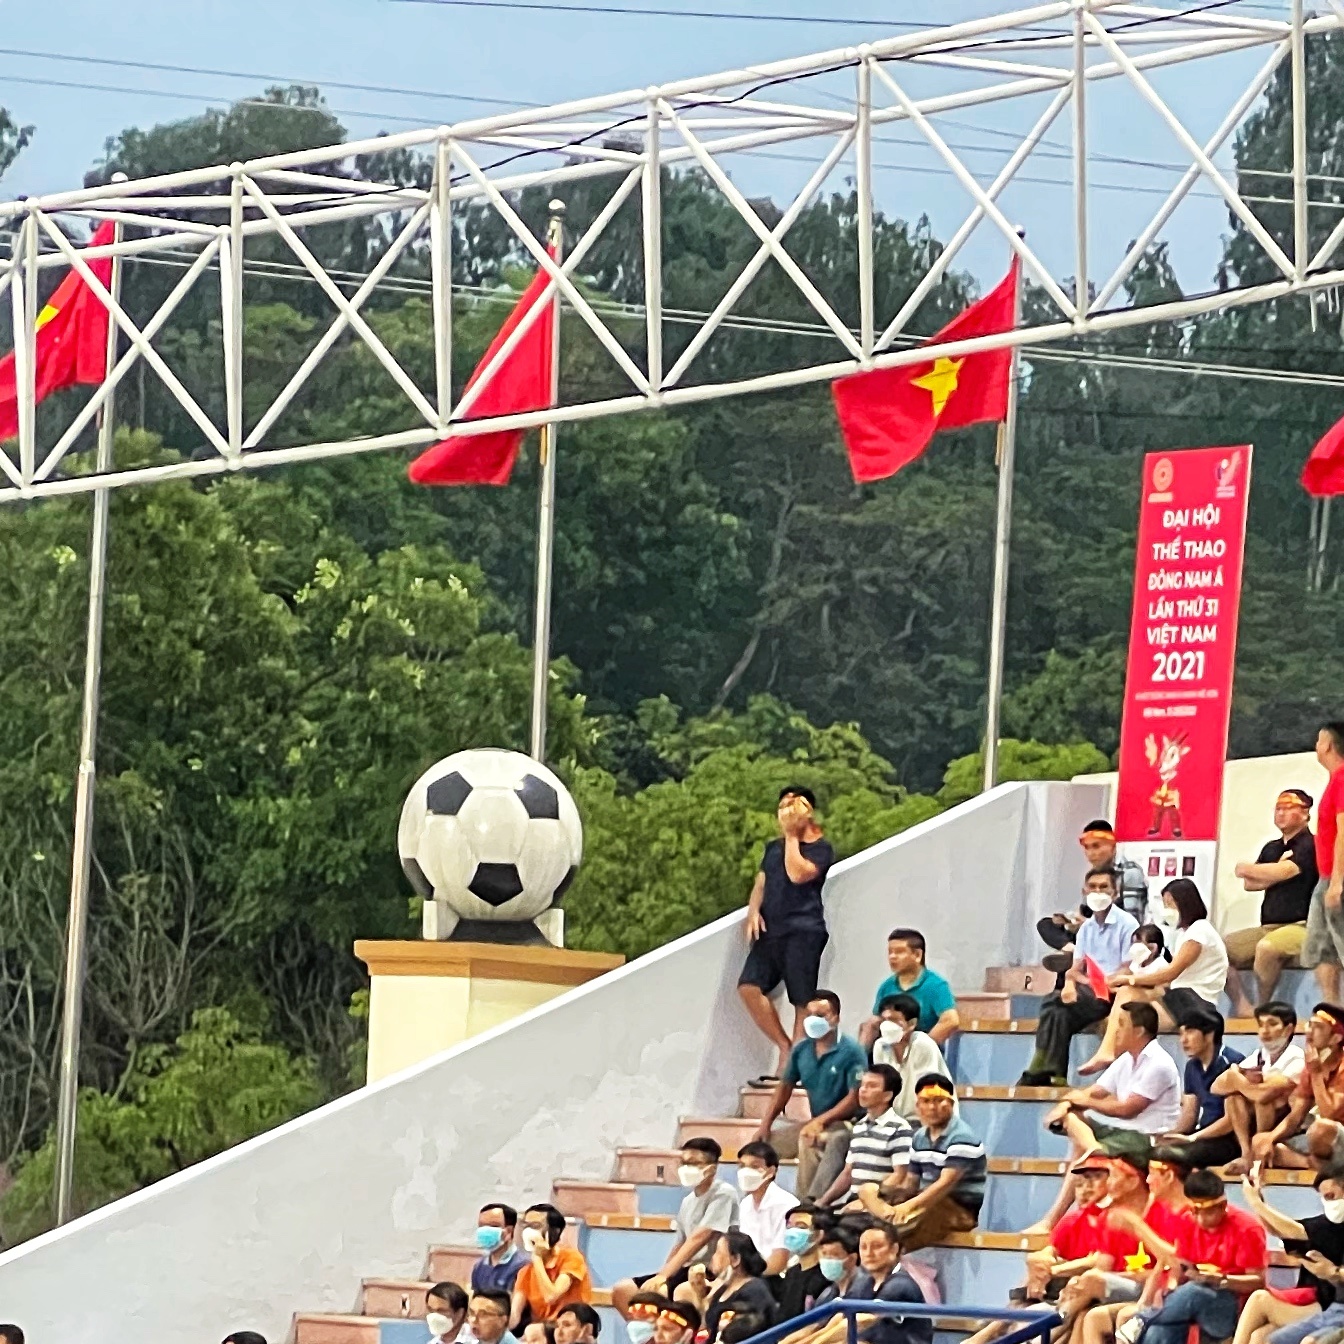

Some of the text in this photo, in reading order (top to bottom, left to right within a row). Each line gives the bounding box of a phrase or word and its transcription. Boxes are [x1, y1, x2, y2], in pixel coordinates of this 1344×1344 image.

[1163, 503, 1220, 532] ĐẠI HỘI
[1183, 539, 1226, 559] THAO
[1147, 565, 1223, 590] ĐÔNG NAM Á
[1205, 598, 1219, 617] 31
[1147, 623, 1217, 648] VIỆT NAM
[1151, 651, 1205, 682] 2021
